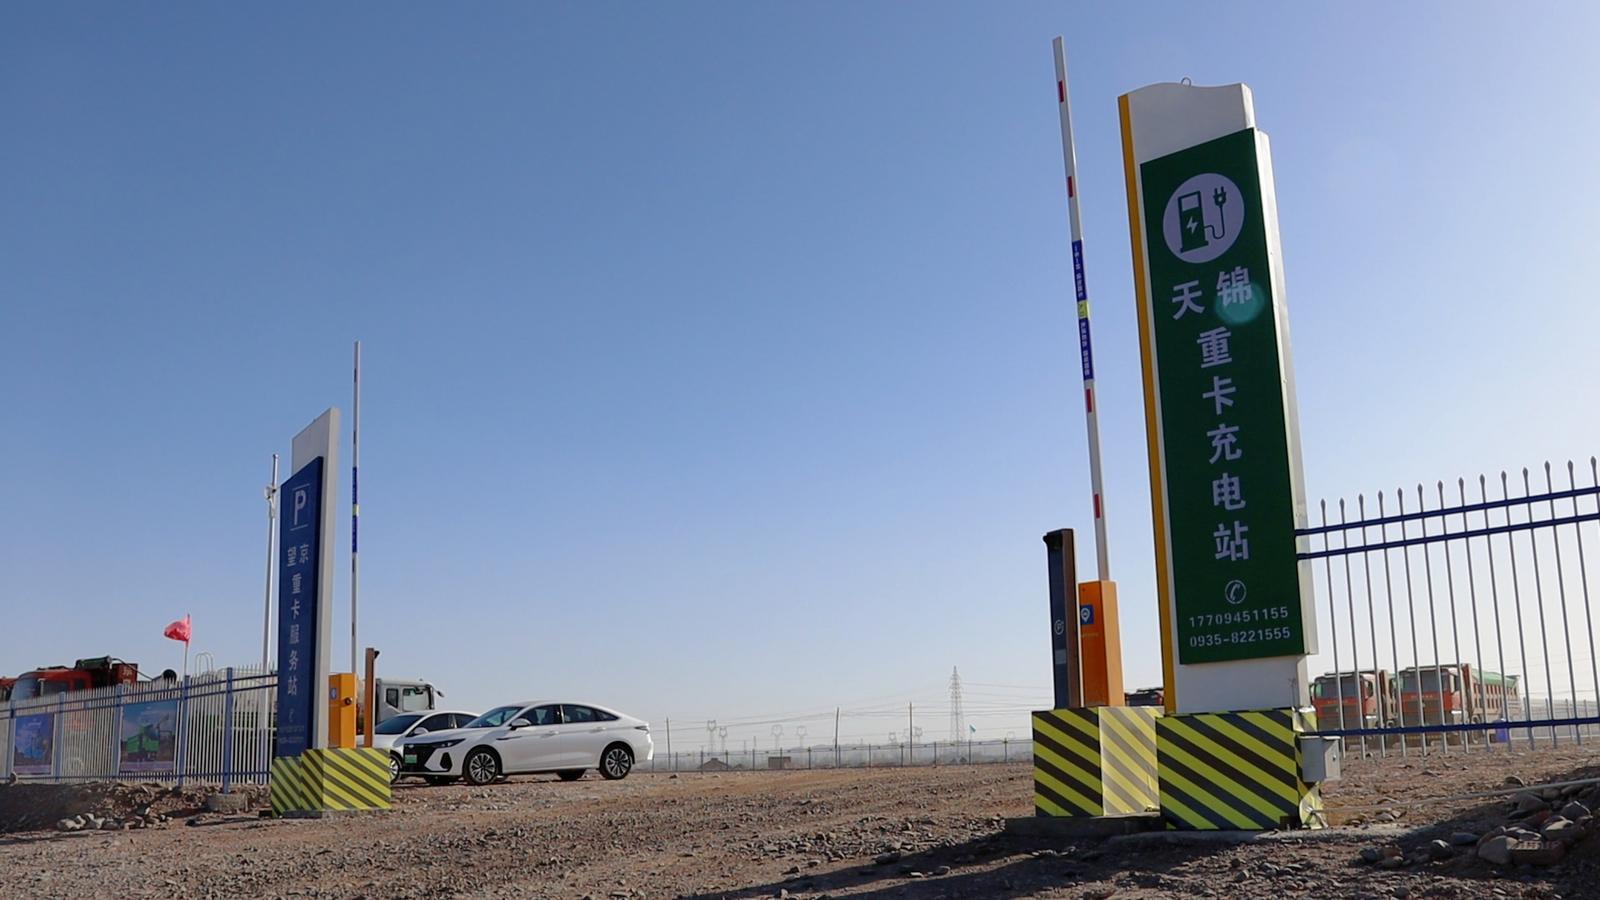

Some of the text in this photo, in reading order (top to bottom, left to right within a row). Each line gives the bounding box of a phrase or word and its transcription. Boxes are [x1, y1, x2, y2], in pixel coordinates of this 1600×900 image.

[1197, 326, 1250, 562] 重卡充电站
[293, 489, 306, 526] P
[1189, 606, 1289, 628] 17709451155
[1189, 626, 1291, 648] 0935-8221555
